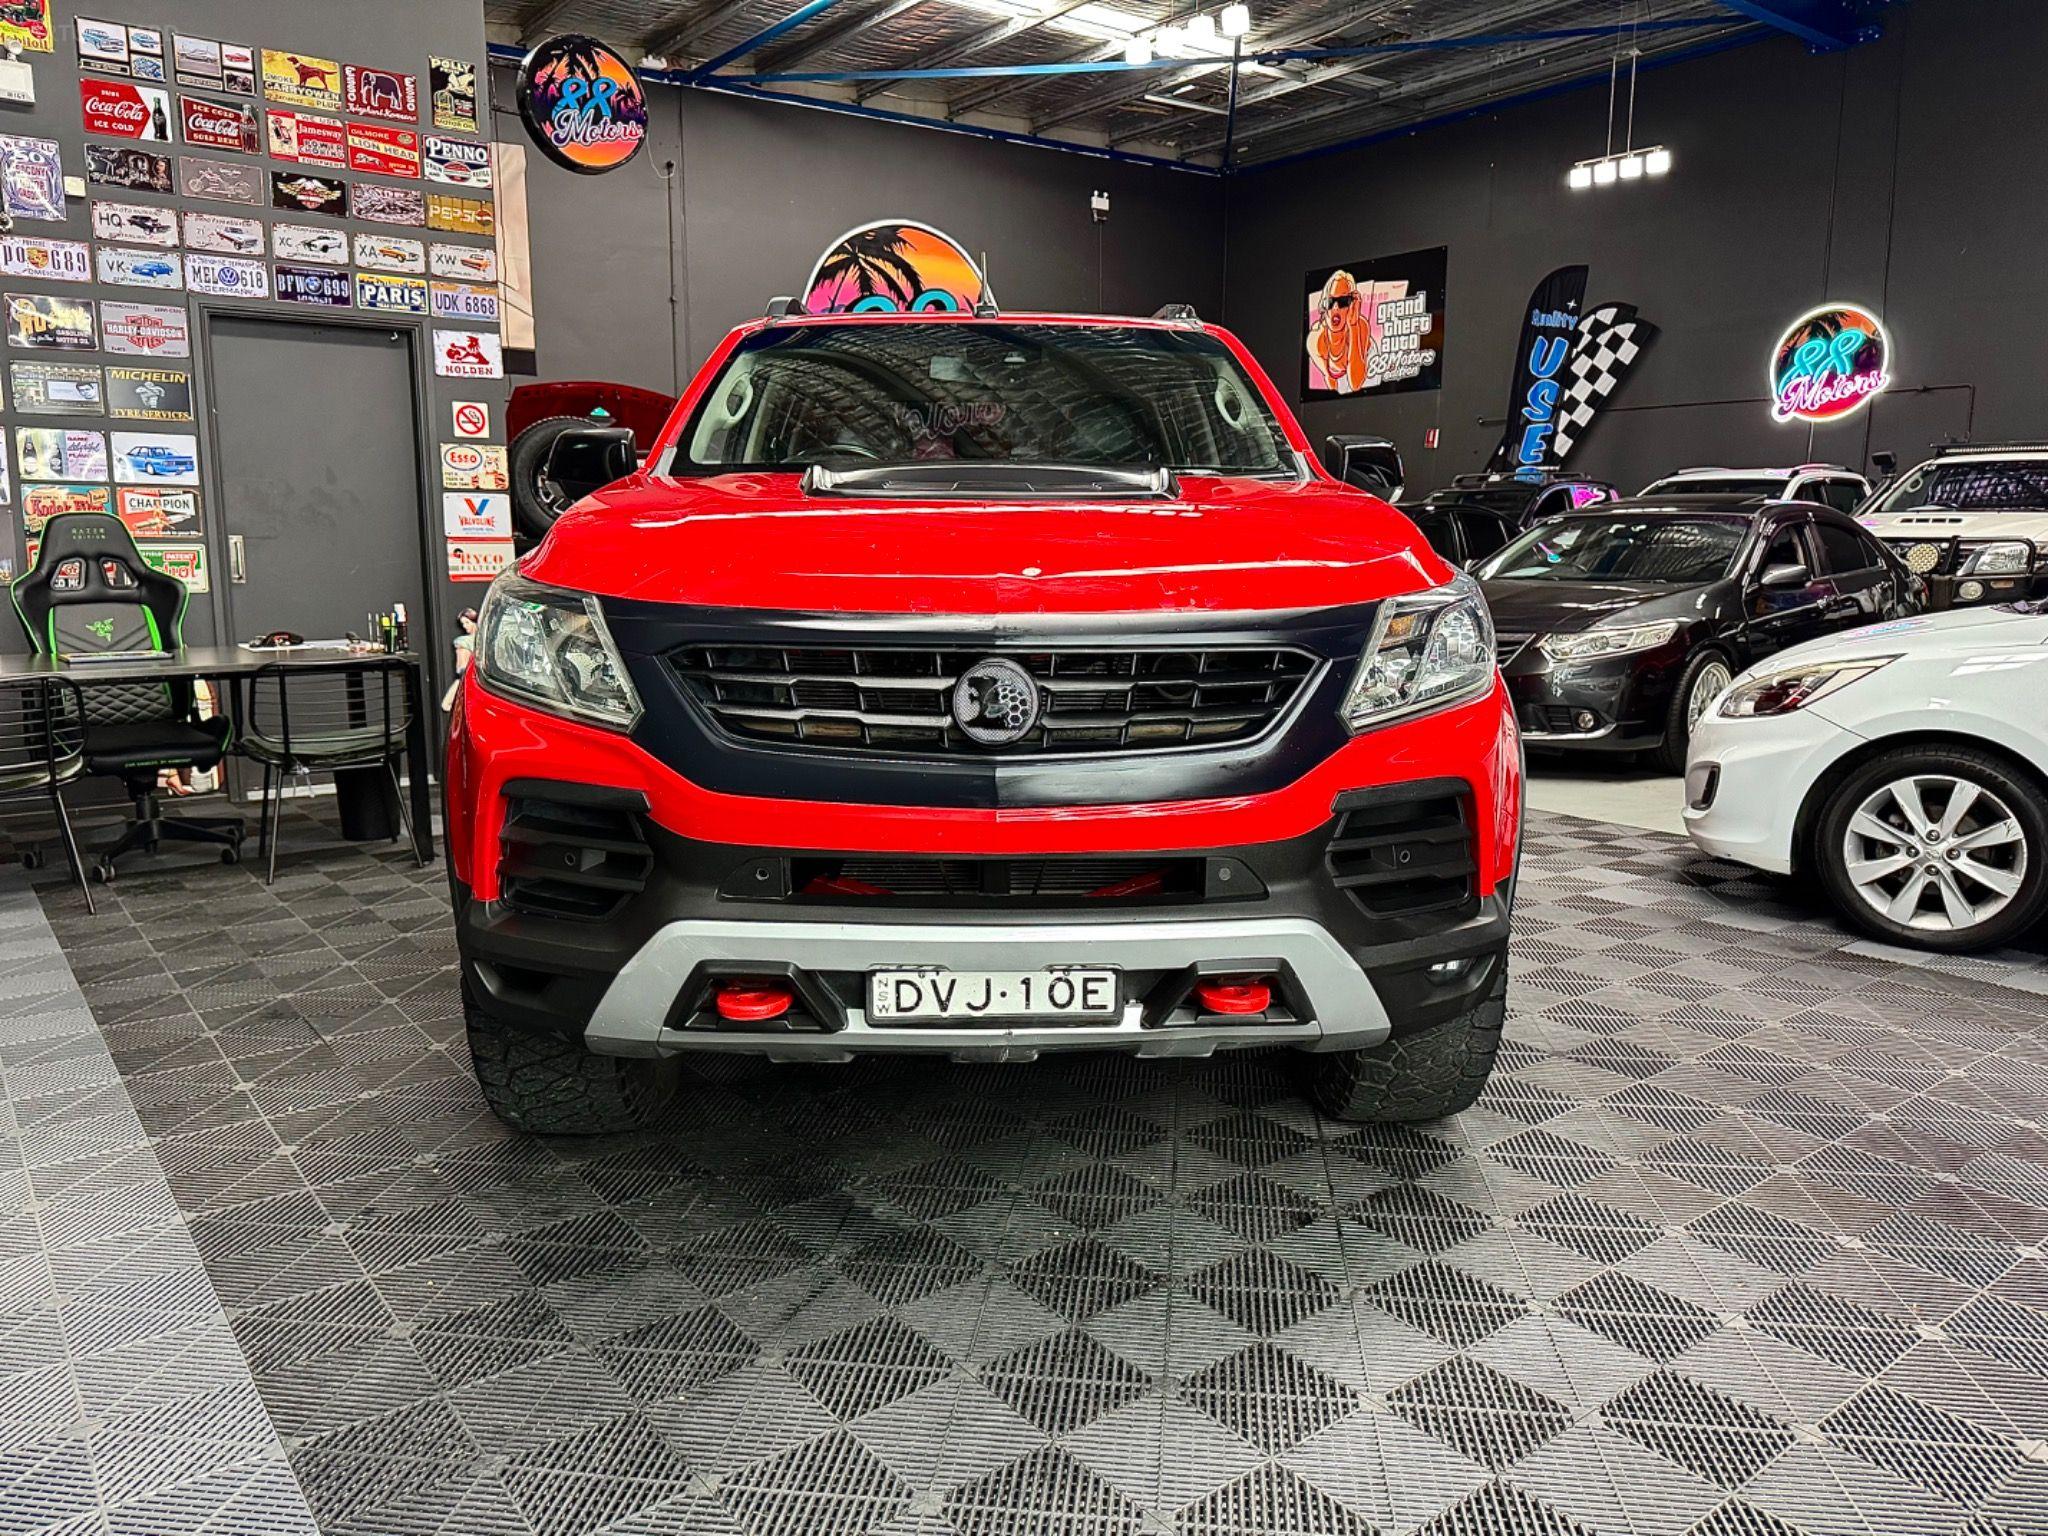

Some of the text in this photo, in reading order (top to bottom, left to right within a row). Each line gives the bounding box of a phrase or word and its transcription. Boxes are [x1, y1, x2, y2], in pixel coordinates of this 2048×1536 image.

[430, 58, 470, 74] POLLY
[265, 72, 294, 83] SMOKE
[264, 81, 340, 102] GARRYOWEN
[551, 77, 618, 121] 88
[86, 96, 146, 121] Coca-Cola
[211, 108, 235, 118] COLD
[94, 120, 134, 131] ICE COLD
[188, 112, 239, 136] Coca-Cola
[296, 123, 342, 141] Jamesway
[350, 128, 390, 140] GILMORE
[550, 108, 646, 147] Motors
[350, 137, 416, 160] LION HEAD
[426, 137, 488, 162] PENNO
[429, 205, 476, 222] PEPSI
[52, 249, 87, 273] 689
[435, 253, 457, 265] XW
[192, 265, 264, 289] MEL 618
[323, 278, 349, 298] 699
[364, 284, 422, 306] PARIS
[435, 292, 496, 316] UDK 6868
[1377, 291, 1425, 324] grand
[1383, 314, 1430, 338] theft
[1532, 309, 1578, 331] Quality
[106, 323, 183, 338] HARLEY-DAVIDSON
[1382, 333, 1418, 353] auto
[445, 365, 493, 376] HOLDEN
[1778, 328, 1868, 395] 88
[111, 370, 186, 383] MICHELIN
[1777, 370, 1890, 417] Motors
[114, 408, 191, 419] TYRE SERVICES
[450, 451, 477, 463] Esso
[30, 499, 72, 517] Kodak
[458, 514, 496, 528] VALVOLINE
[164, 552, 194, 560] PATENT
